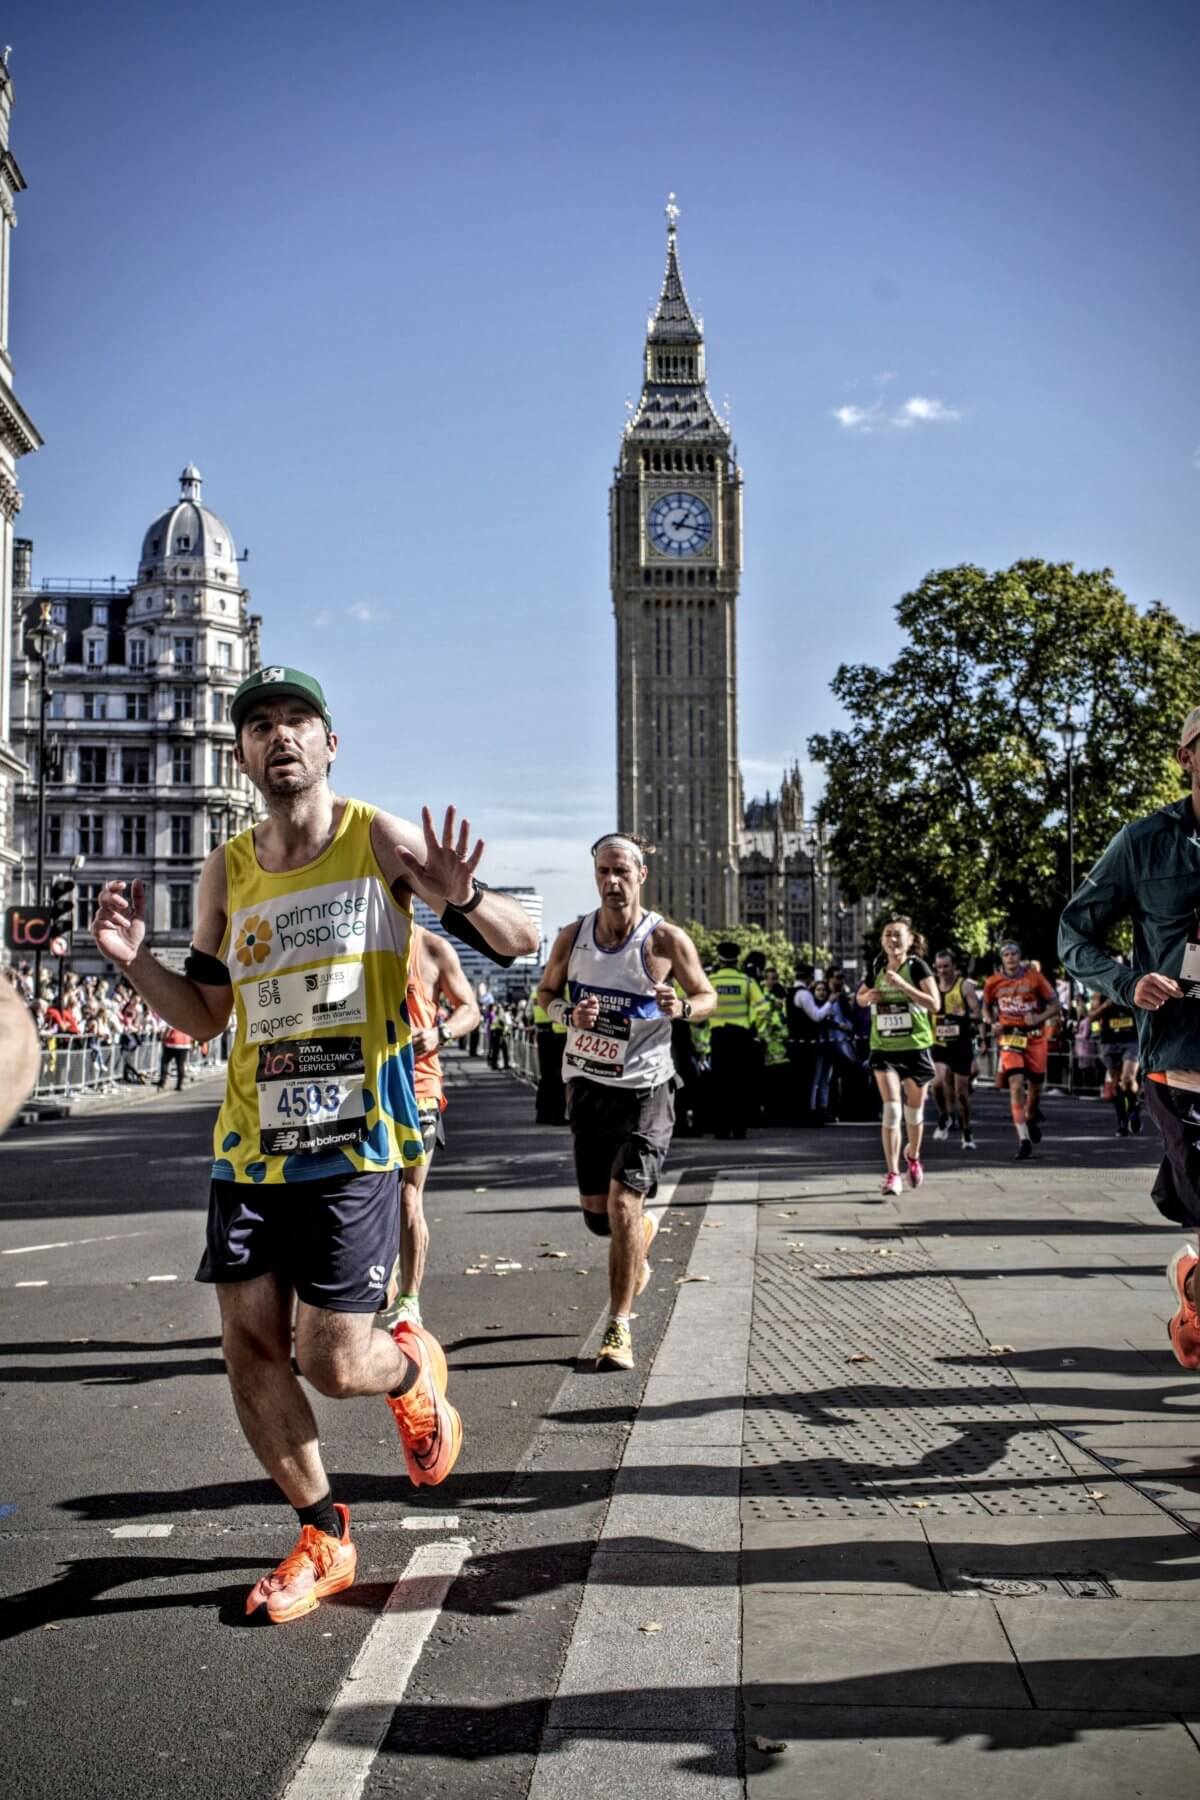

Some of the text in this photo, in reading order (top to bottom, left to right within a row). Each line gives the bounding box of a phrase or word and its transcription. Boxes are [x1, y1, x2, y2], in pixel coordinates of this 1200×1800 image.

[276, 897, 367, 934] primrose
[12, 911, 50, 944] tc
[280, 920, 365, 951] hospice
[332, 1008, 361, 1018] Warwick
[299, 1045, 323, 1054] TATA
[575, 1034, 619, 1059] 42426
[298, 1053, 355, 1064] CONSULTANCY
[298, 1062, 337, 1073] SERVICES
[316, 1132, 356, 1147] balance
